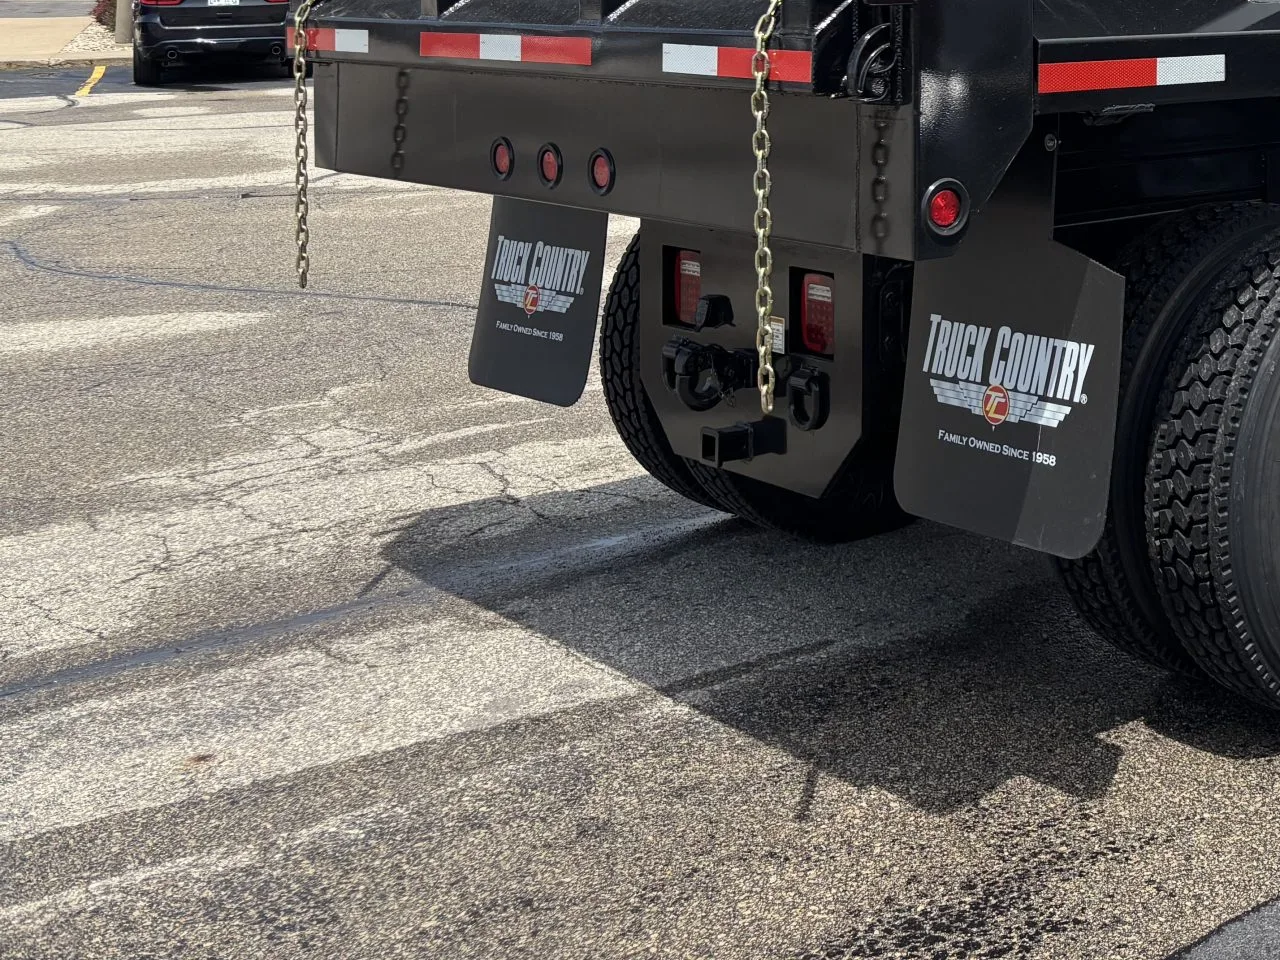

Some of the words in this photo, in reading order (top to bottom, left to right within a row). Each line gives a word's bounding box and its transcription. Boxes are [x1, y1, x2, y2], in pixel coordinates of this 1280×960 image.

[491, 235, 533, 284] TRUCK
[495, 320, 514, 331] FAMILY
[513, 324, 533, 336] OWNED
[532, 328, 548, 339] SINCE
[549, 331, 564, 342] 1958
[922, 313, 992, 383] TRUCK
[938, 429, 968, 446] FAMILY
[968, 437, 1001, 454] OWNED
[1002, 444, 1030, 461] SINCE
[1032, 451, 1057, 467] 1958
